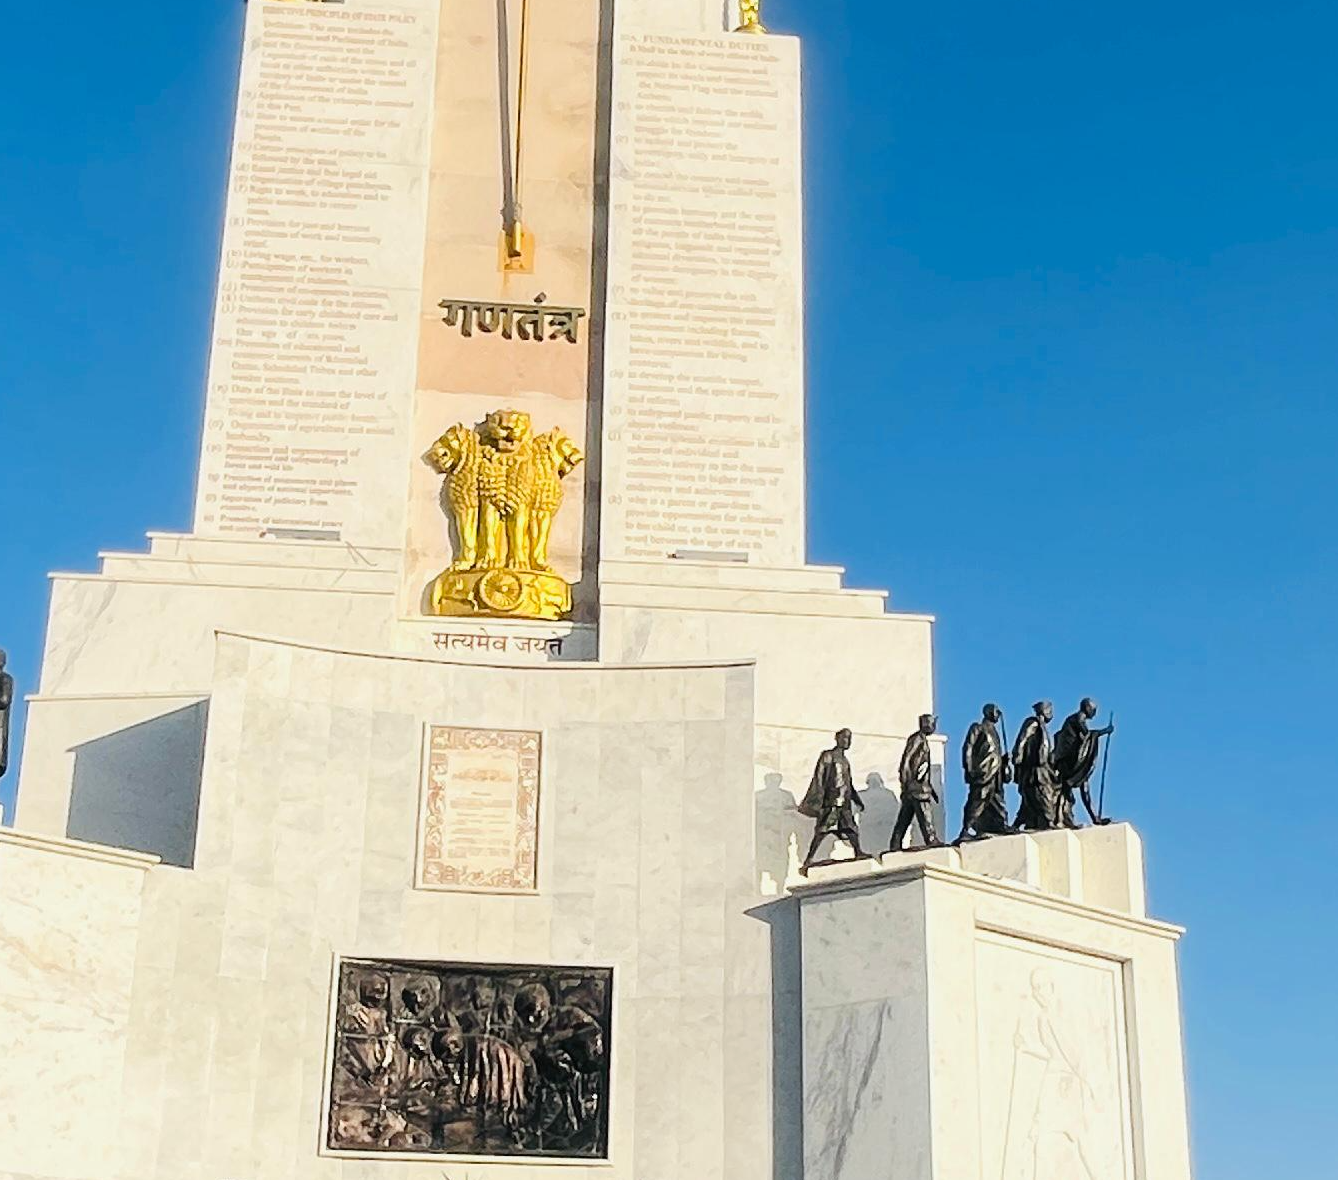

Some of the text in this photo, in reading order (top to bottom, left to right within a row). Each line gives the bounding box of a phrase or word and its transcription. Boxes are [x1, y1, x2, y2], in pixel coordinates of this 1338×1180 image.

[438, 292, 586, 344] गणतंत्र
[431, 627, 563, 656] सत्यमेव जयते
